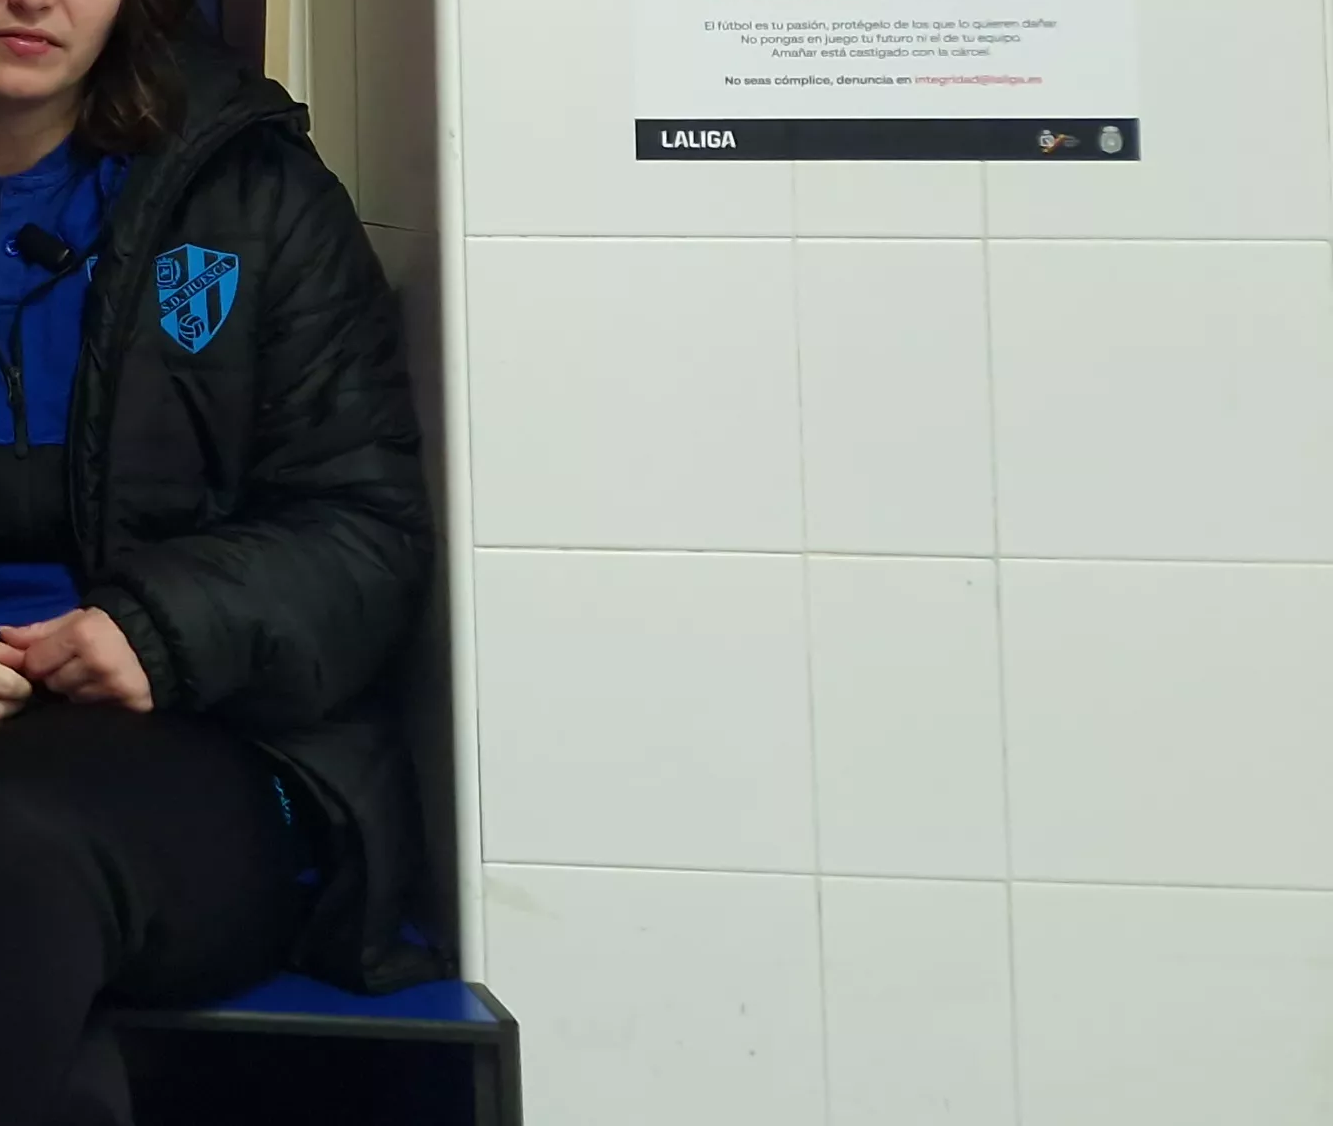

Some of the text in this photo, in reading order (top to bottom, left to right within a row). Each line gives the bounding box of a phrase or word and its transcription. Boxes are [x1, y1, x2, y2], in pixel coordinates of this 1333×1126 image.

[718, 21, 752, 31] fútbol
[771, 22, 784, 31] tu
[832, 20, 891, 32] protégelo
[894, 20, 910, 30] de
[741, 35, 758, 44] No
[760, 35, 804, 46] pongas
[807, 36, 822, 44] en
[825, 34, 858, 45] juego
[862, 35, 874, 44] tu
[876, 34, 913, 43] futuro
[943, 34, 959, 43] de
[962, 34, 975, 43] tu
[820, 48, 846, 58] está
[849, 48, 909, 59] castigado
[912, 49, 935, 57] con
[724, 76, 741, 86] No
[744, 77, 772, 85] seas
[774, 76, 833, 87] cómplice,
[836, 76, 894, 85] denuncia
[896, 77, 912, 85] en
[661, 130, 737, 149] LALIGA
